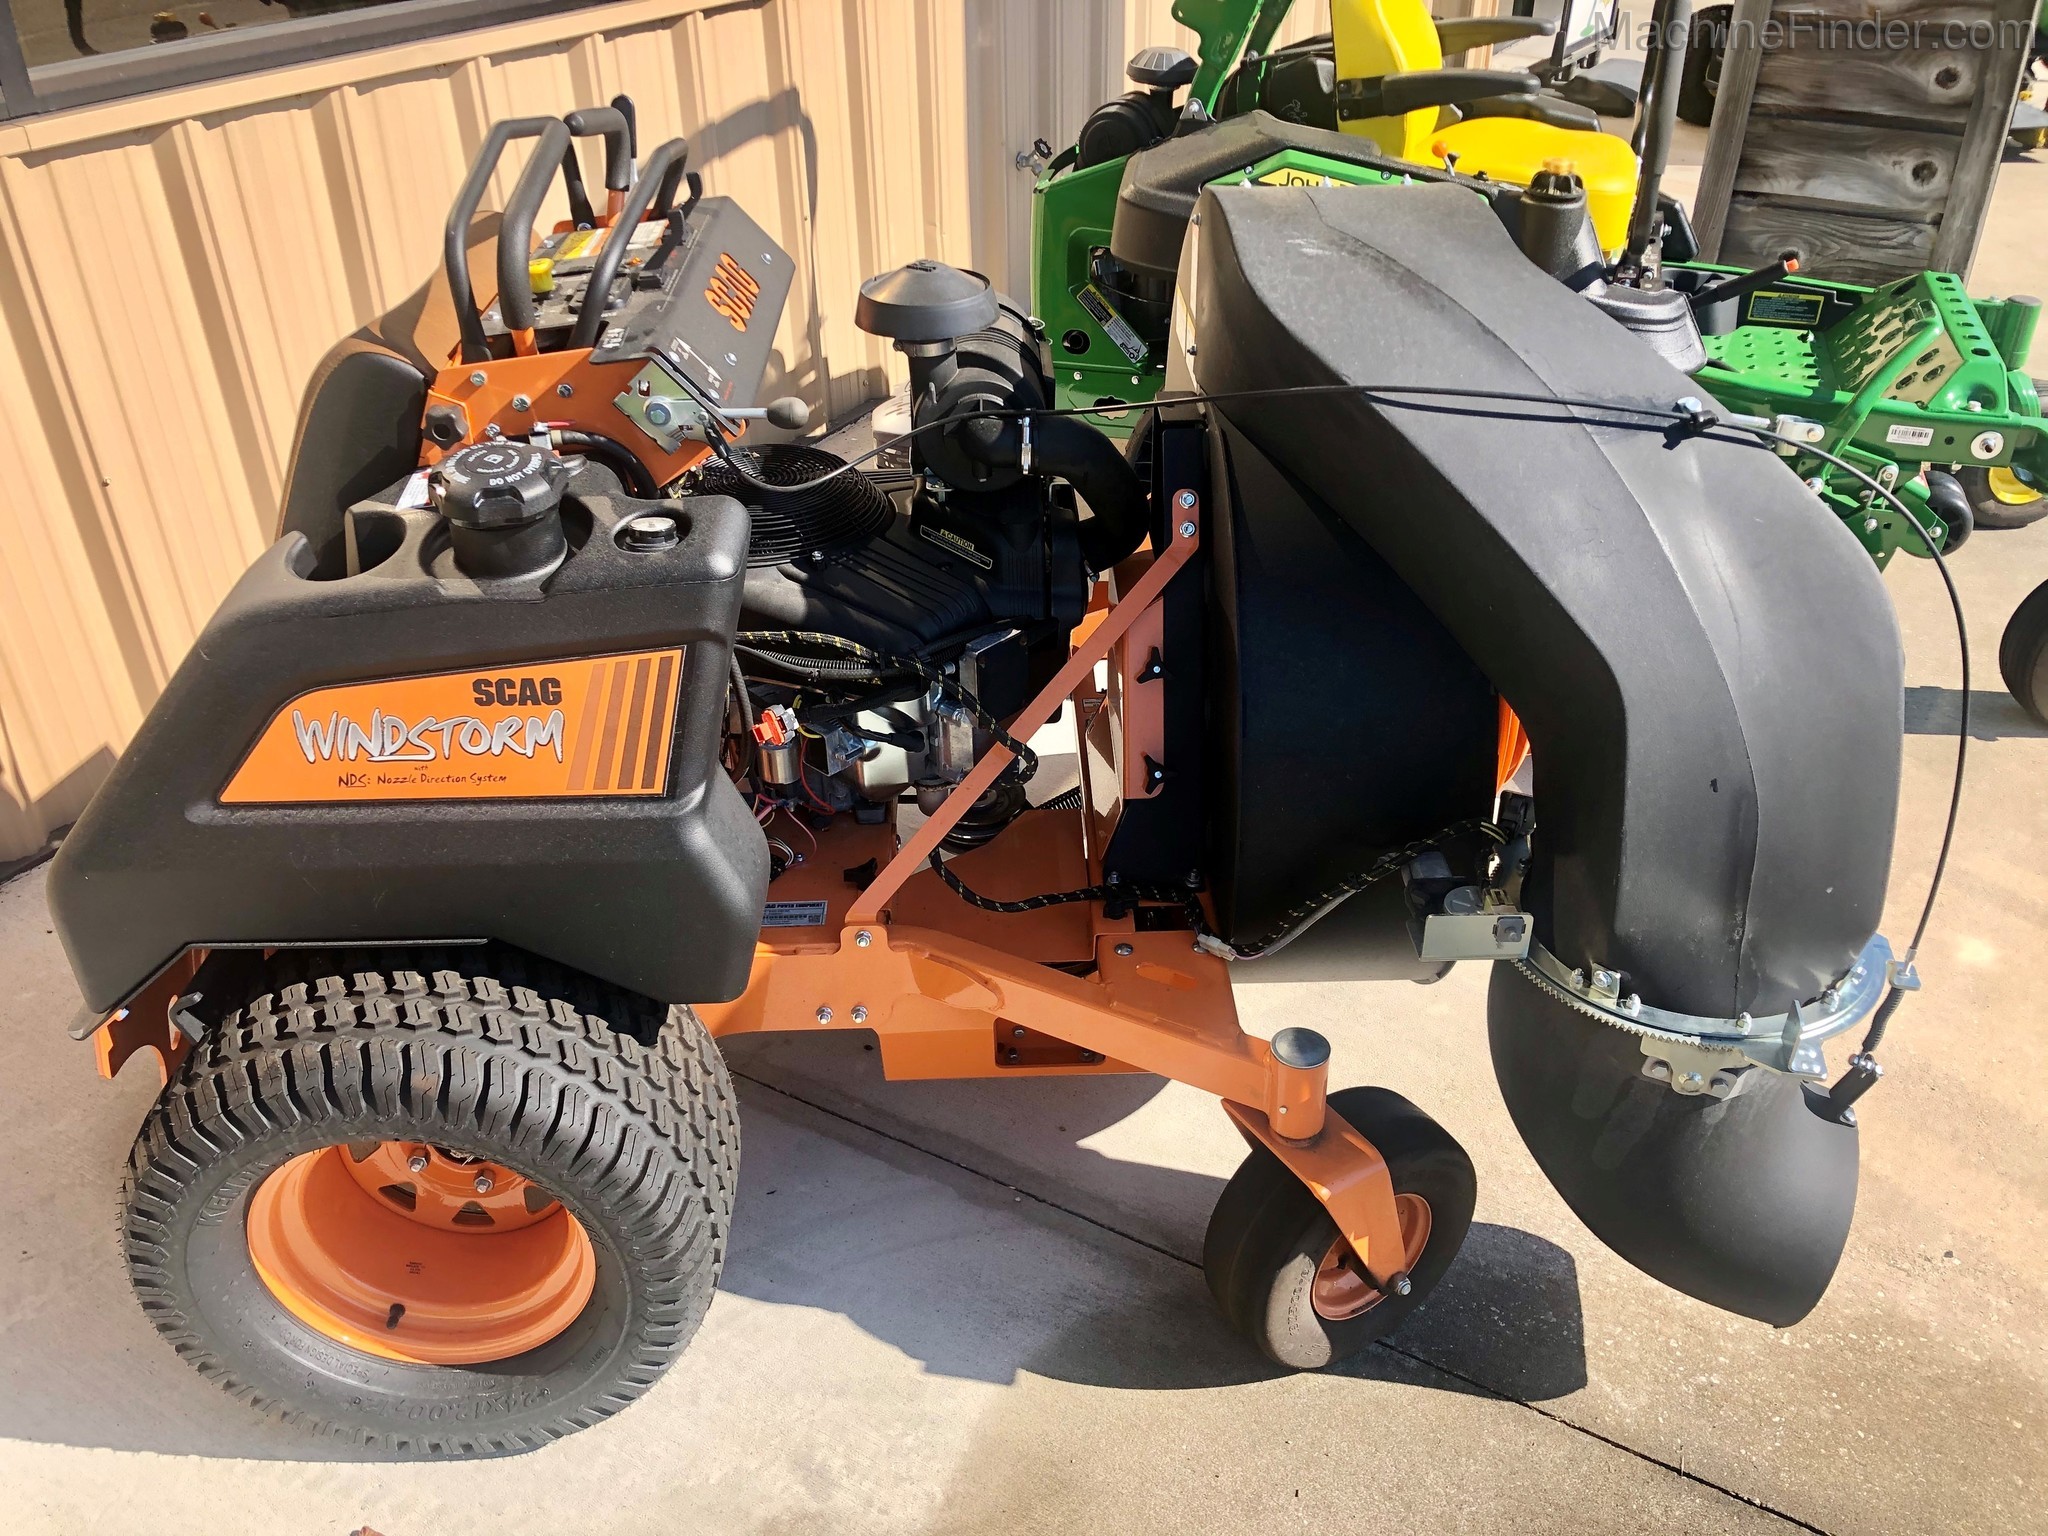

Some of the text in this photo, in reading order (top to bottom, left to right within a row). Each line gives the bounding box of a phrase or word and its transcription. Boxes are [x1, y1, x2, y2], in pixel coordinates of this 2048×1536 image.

[704, 252, 760, 332] SCAG
[489, 477, 504, 486] DO
[505, 471, 525, 483] NOT
[472, 677, 562, 706] SCAG
[292, 707, 565, 764] WINDSTORM
[338, 771, 507, 787] NDS: Nozzle Direction System
